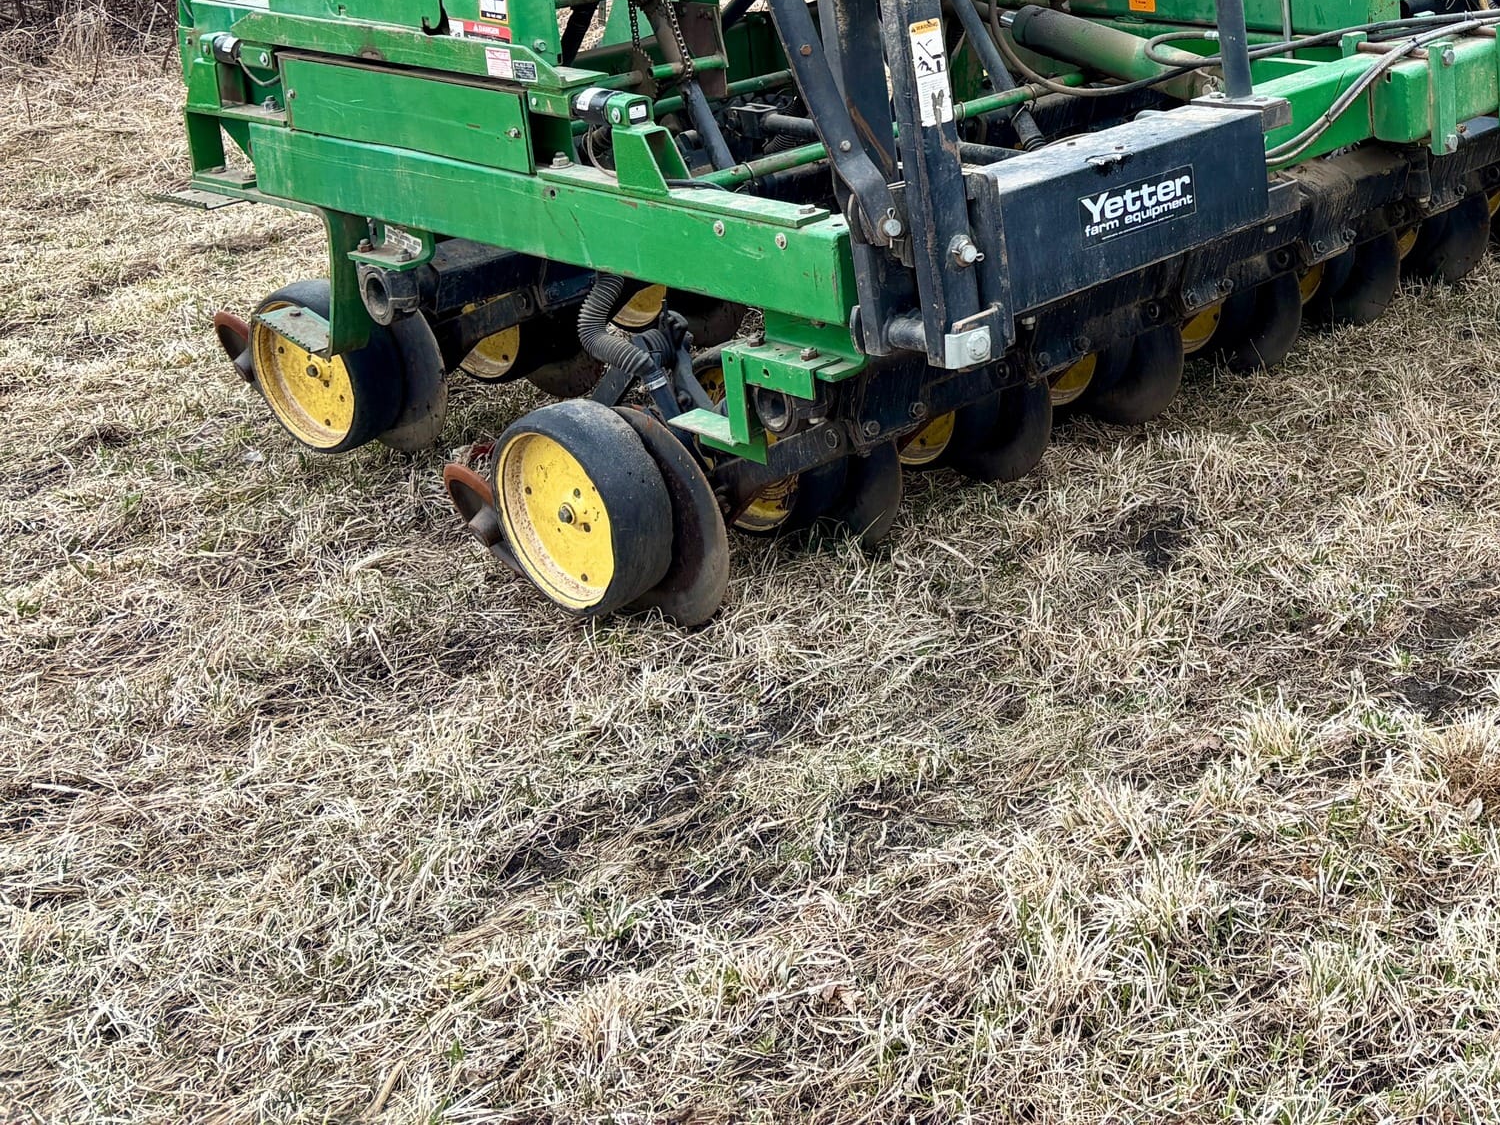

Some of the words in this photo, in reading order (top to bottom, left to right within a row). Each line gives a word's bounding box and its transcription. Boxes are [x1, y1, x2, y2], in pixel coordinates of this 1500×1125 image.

[478, 25, 500, 35] DANGER
[1081, 175, 1191, 223] Yetter
[1085, 219, 1119, 237] farm
[1124, 194, 1193, 223] equipment
